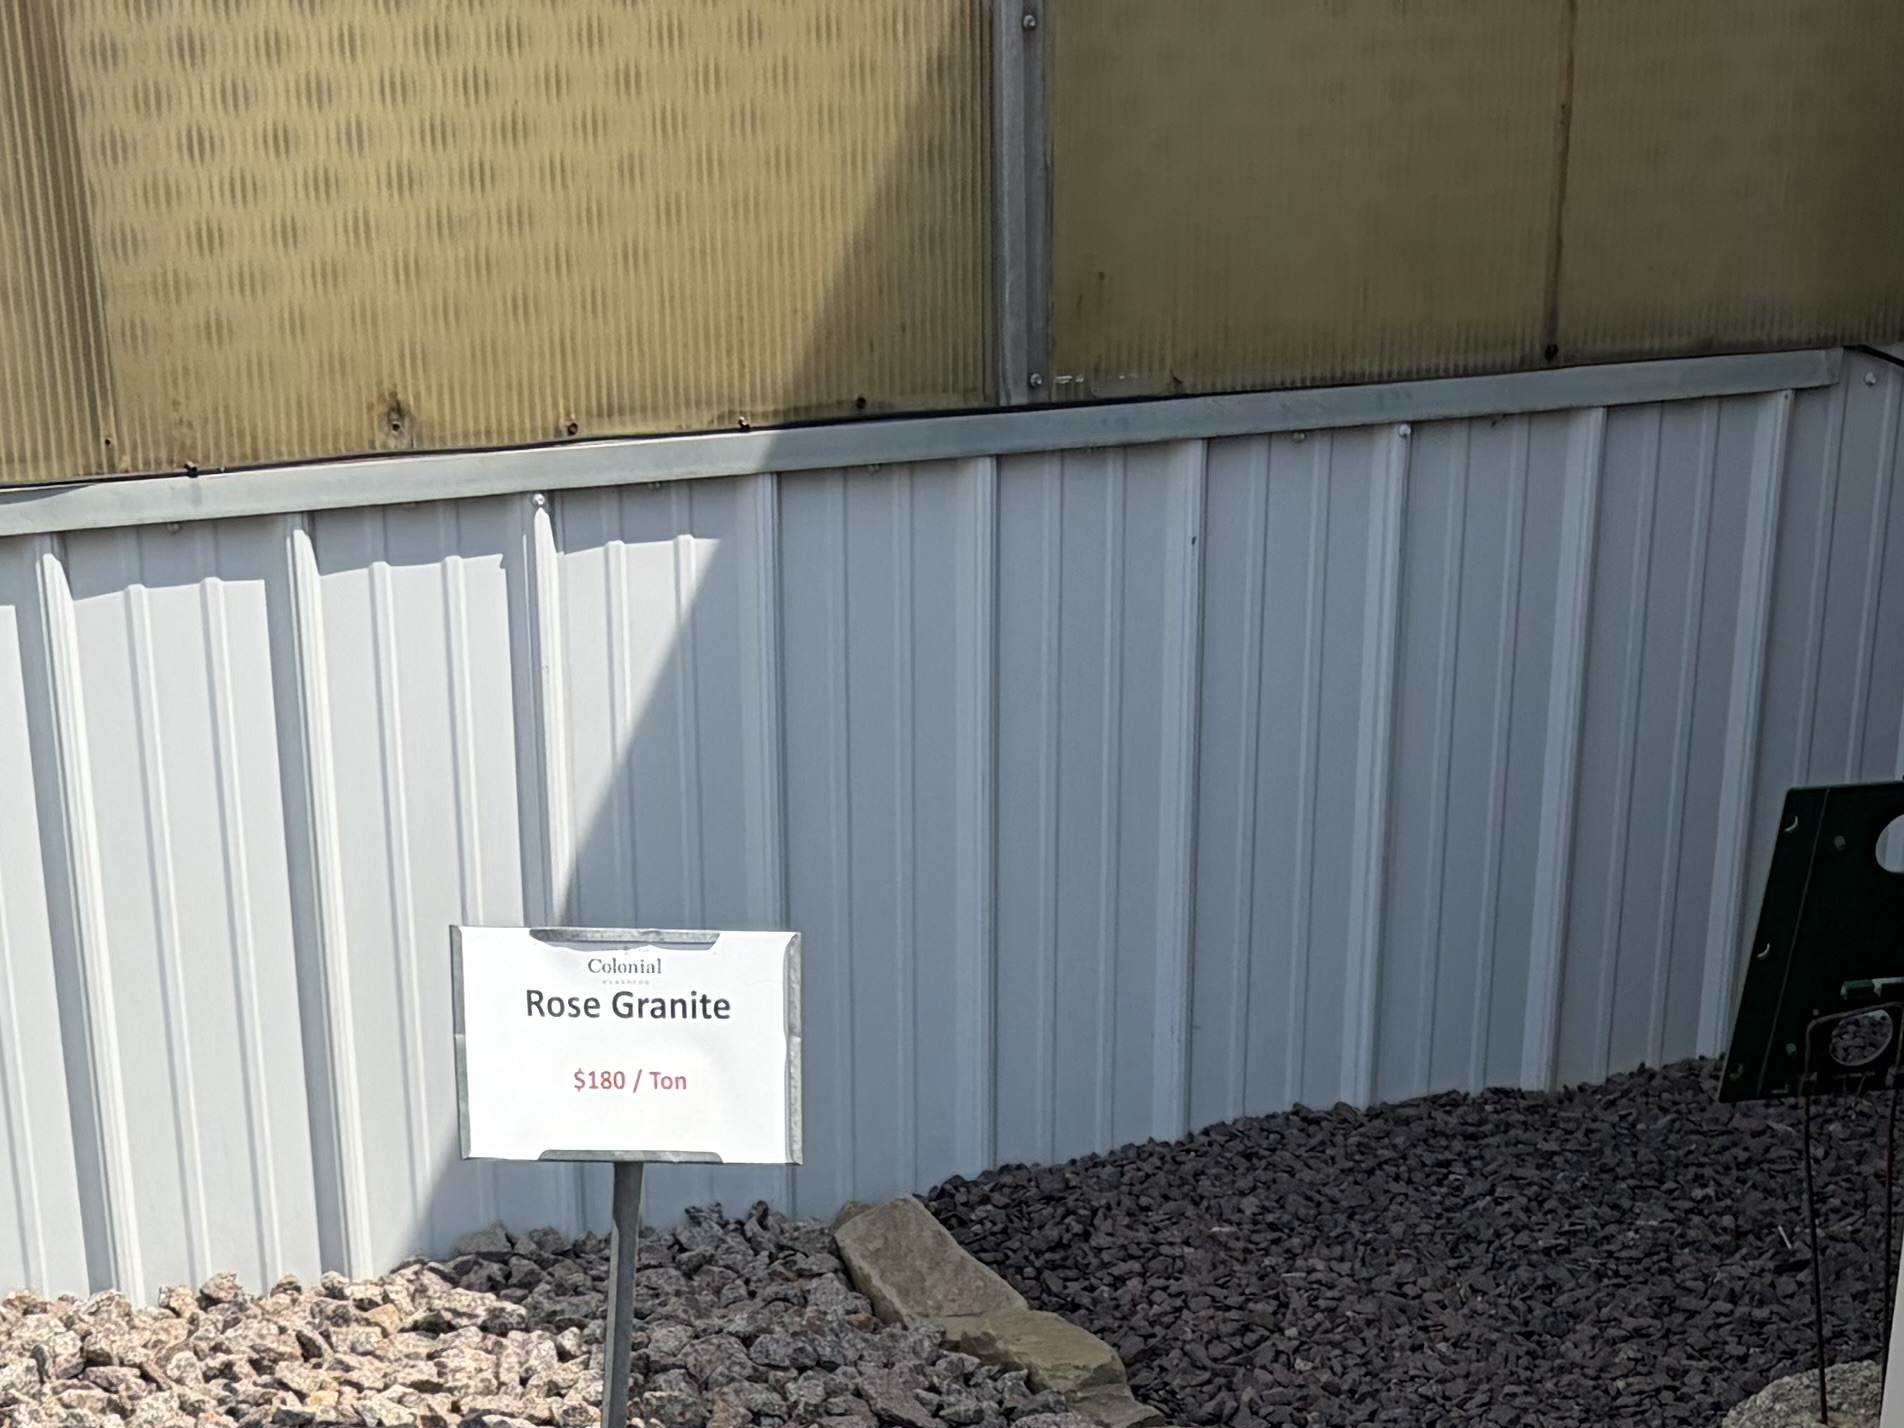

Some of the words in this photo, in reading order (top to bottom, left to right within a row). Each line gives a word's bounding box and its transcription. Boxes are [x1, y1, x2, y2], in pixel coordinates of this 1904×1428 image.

[587, 957, 662, 975] Colonial
[526, 989, 601, 1019] Rose
[611, 990, 731, 1020] Granite
[573, 1067, 626, 1092] $180
[632, 1068, 643, 1094] /
[648, 1071, 687, 1090] Ton
